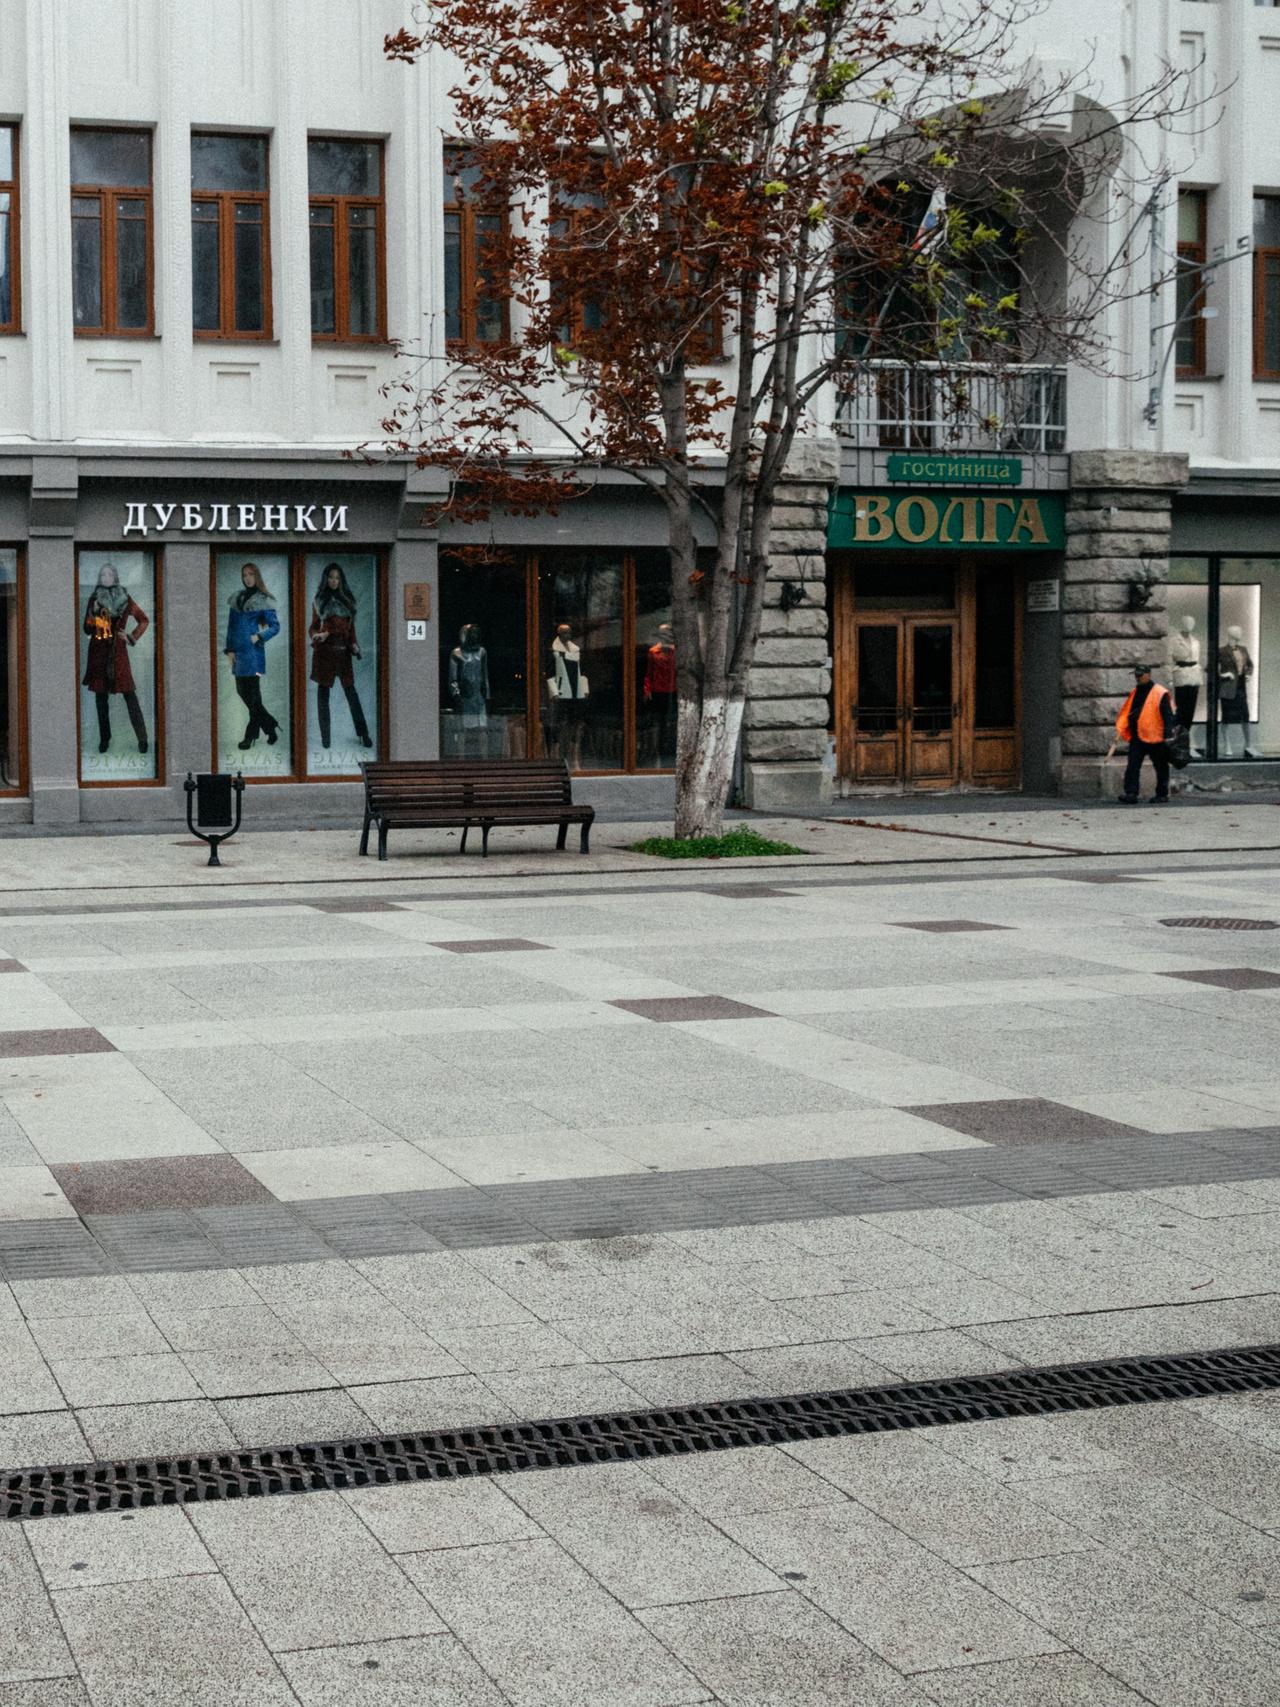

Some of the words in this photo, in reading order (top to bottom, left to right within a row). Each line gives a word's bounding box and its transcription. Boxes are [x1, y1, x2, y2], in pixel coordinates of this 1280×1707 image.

[902, 461, 1010, 480] гостиница
[123, 503, 349, 536] ДУБЛЕНКИ
[852, 495, 1050, 544] ВОЛГА
[410, 625, 423, 636] 34
